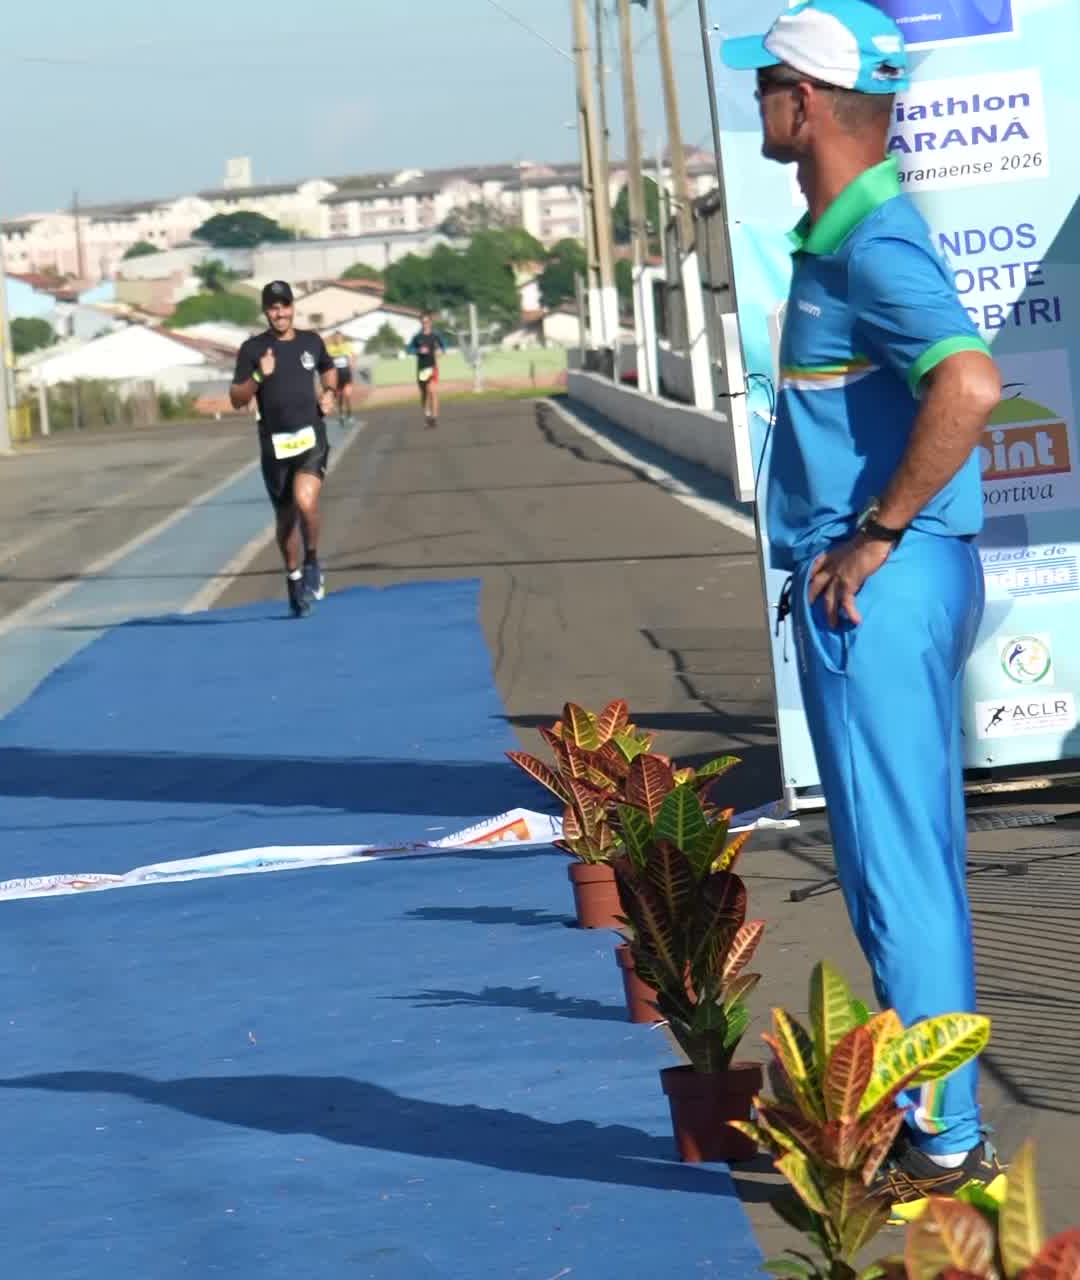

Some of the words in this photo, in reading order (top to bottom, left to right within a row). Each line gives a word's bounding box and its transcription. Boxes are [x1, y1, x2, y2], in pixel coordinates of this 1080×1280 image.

[895, 93, 1030, 122] iathlon
[887, 116, 1030, 154] ARANÁ
[896, 161, 993, 183] aranaense
[1000, 152, 1043, 171] 2026
[938, 223, 1037, 256] NDOS
[954, 260, 1045, 294] ORTE
[983, 480, 1055, 505] ortiva
[983, 546, 1037, 563] idade
[1043, 543, 1067, 556] de
[1012, 700, 1068, 718] ACLR
